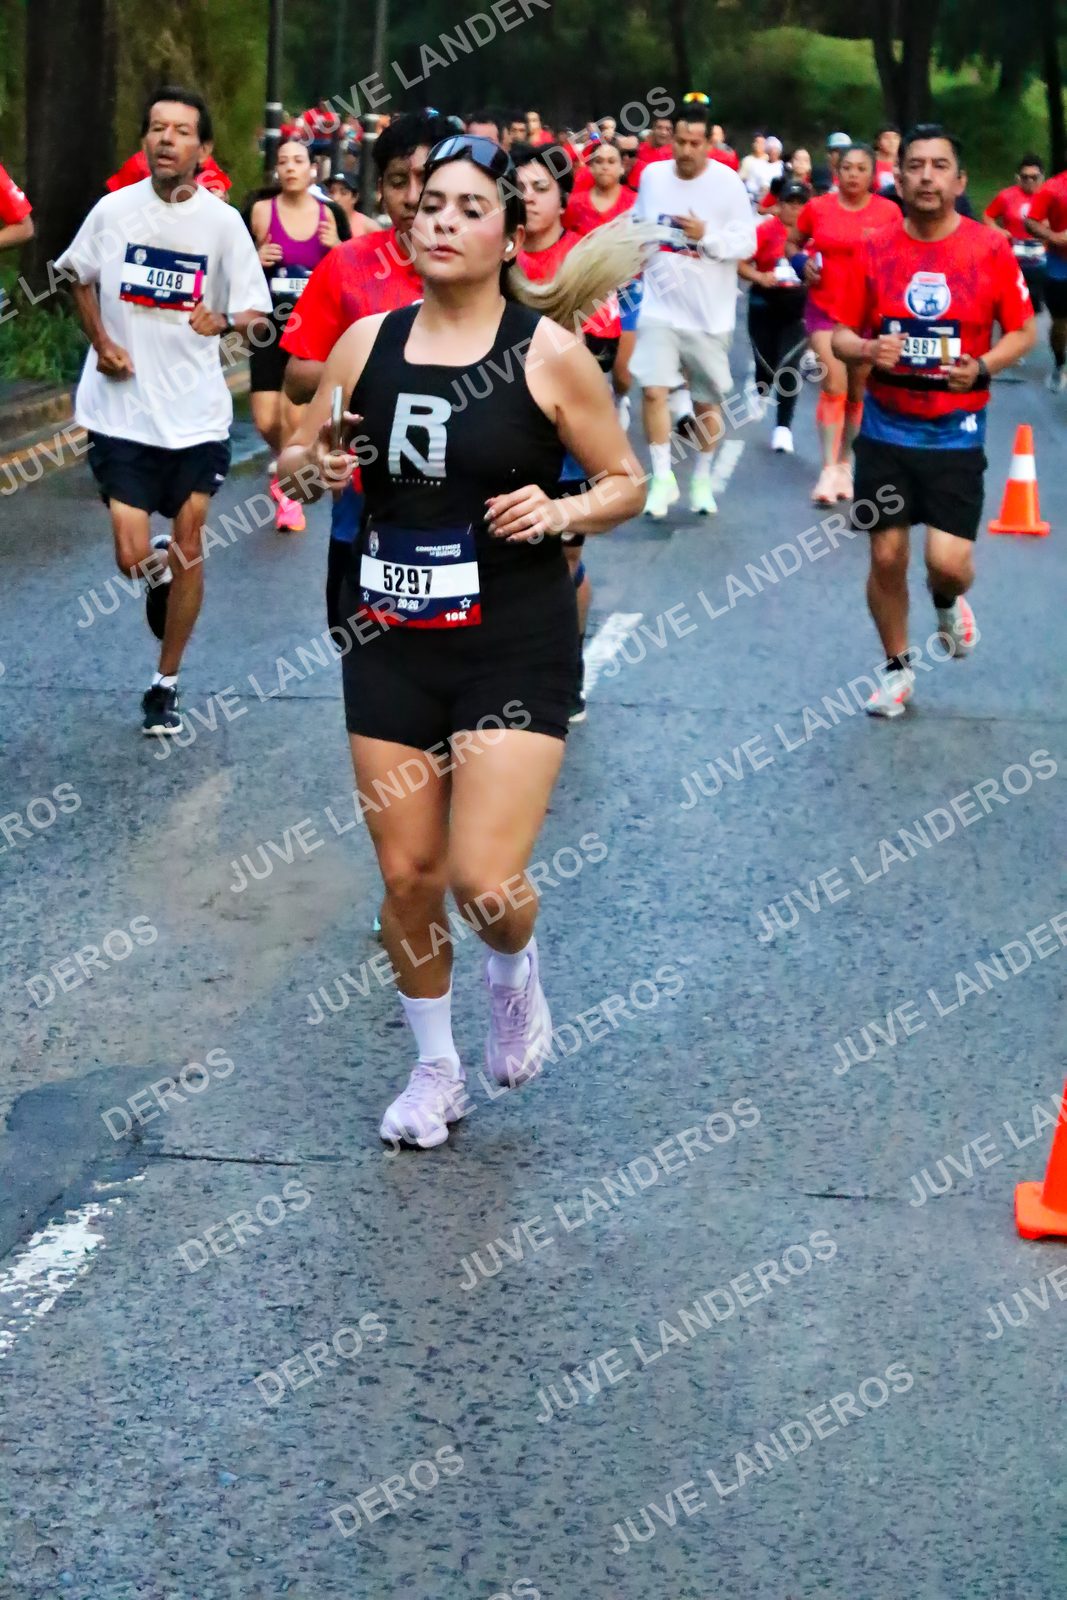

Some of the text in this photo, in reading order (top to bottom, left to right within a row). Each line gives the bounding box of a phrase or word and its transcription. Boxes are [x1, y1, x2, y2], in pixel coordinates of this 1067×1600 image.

[147, 269, 183, 289] 4048
[383, 564, 432, 595] 5297
[445, 611, 468, 621] 10K
